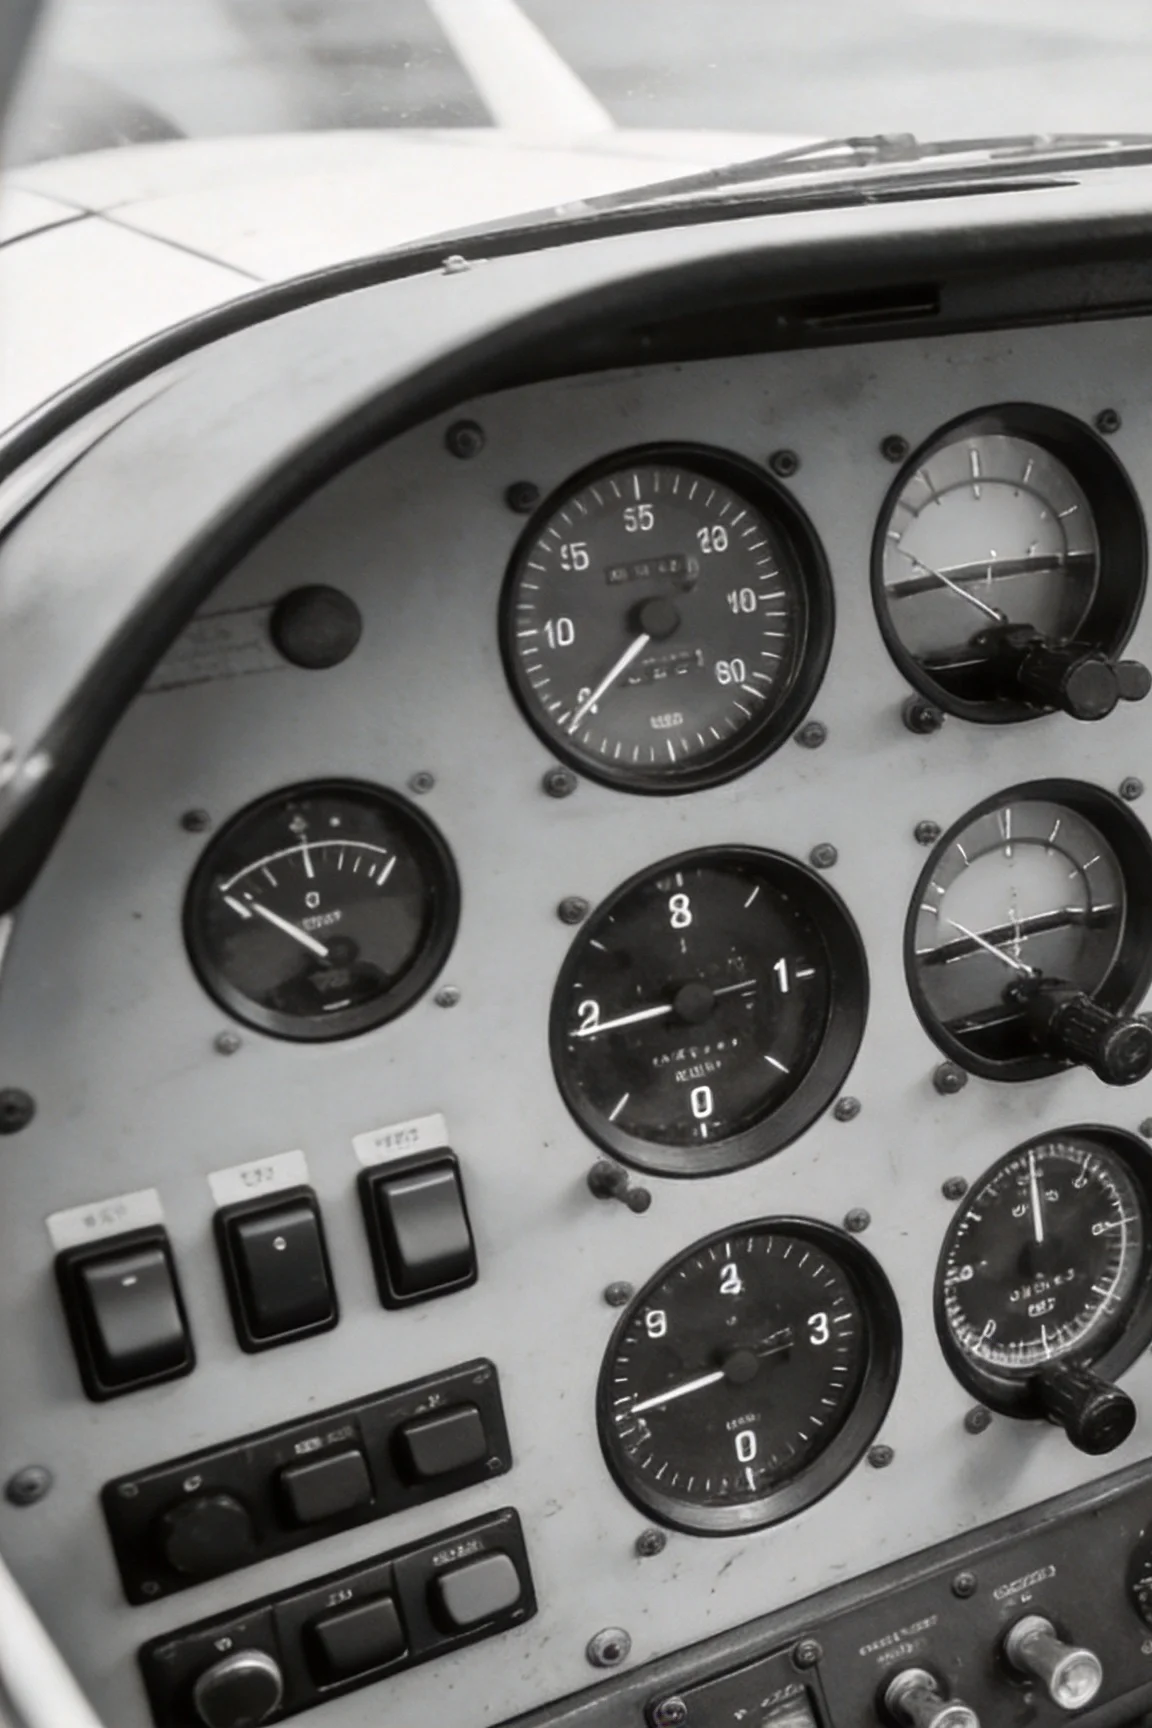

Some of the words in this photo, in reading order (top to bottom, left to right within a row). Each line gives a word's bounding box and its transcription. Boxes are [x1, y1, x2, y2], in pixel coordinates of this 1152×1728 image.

[543, 616, 576, 649] 10
[668, 892, 692, 929] 8
[773, 957, 789, 993] 1
[577, 999, 601, 1035] 2
[690, 1085, 713, 1119] 0
[645, 1310, 667, 1339] 9
[806, 1311, 830, 1346] 3
[734, 1430, 758, 1463] 0
